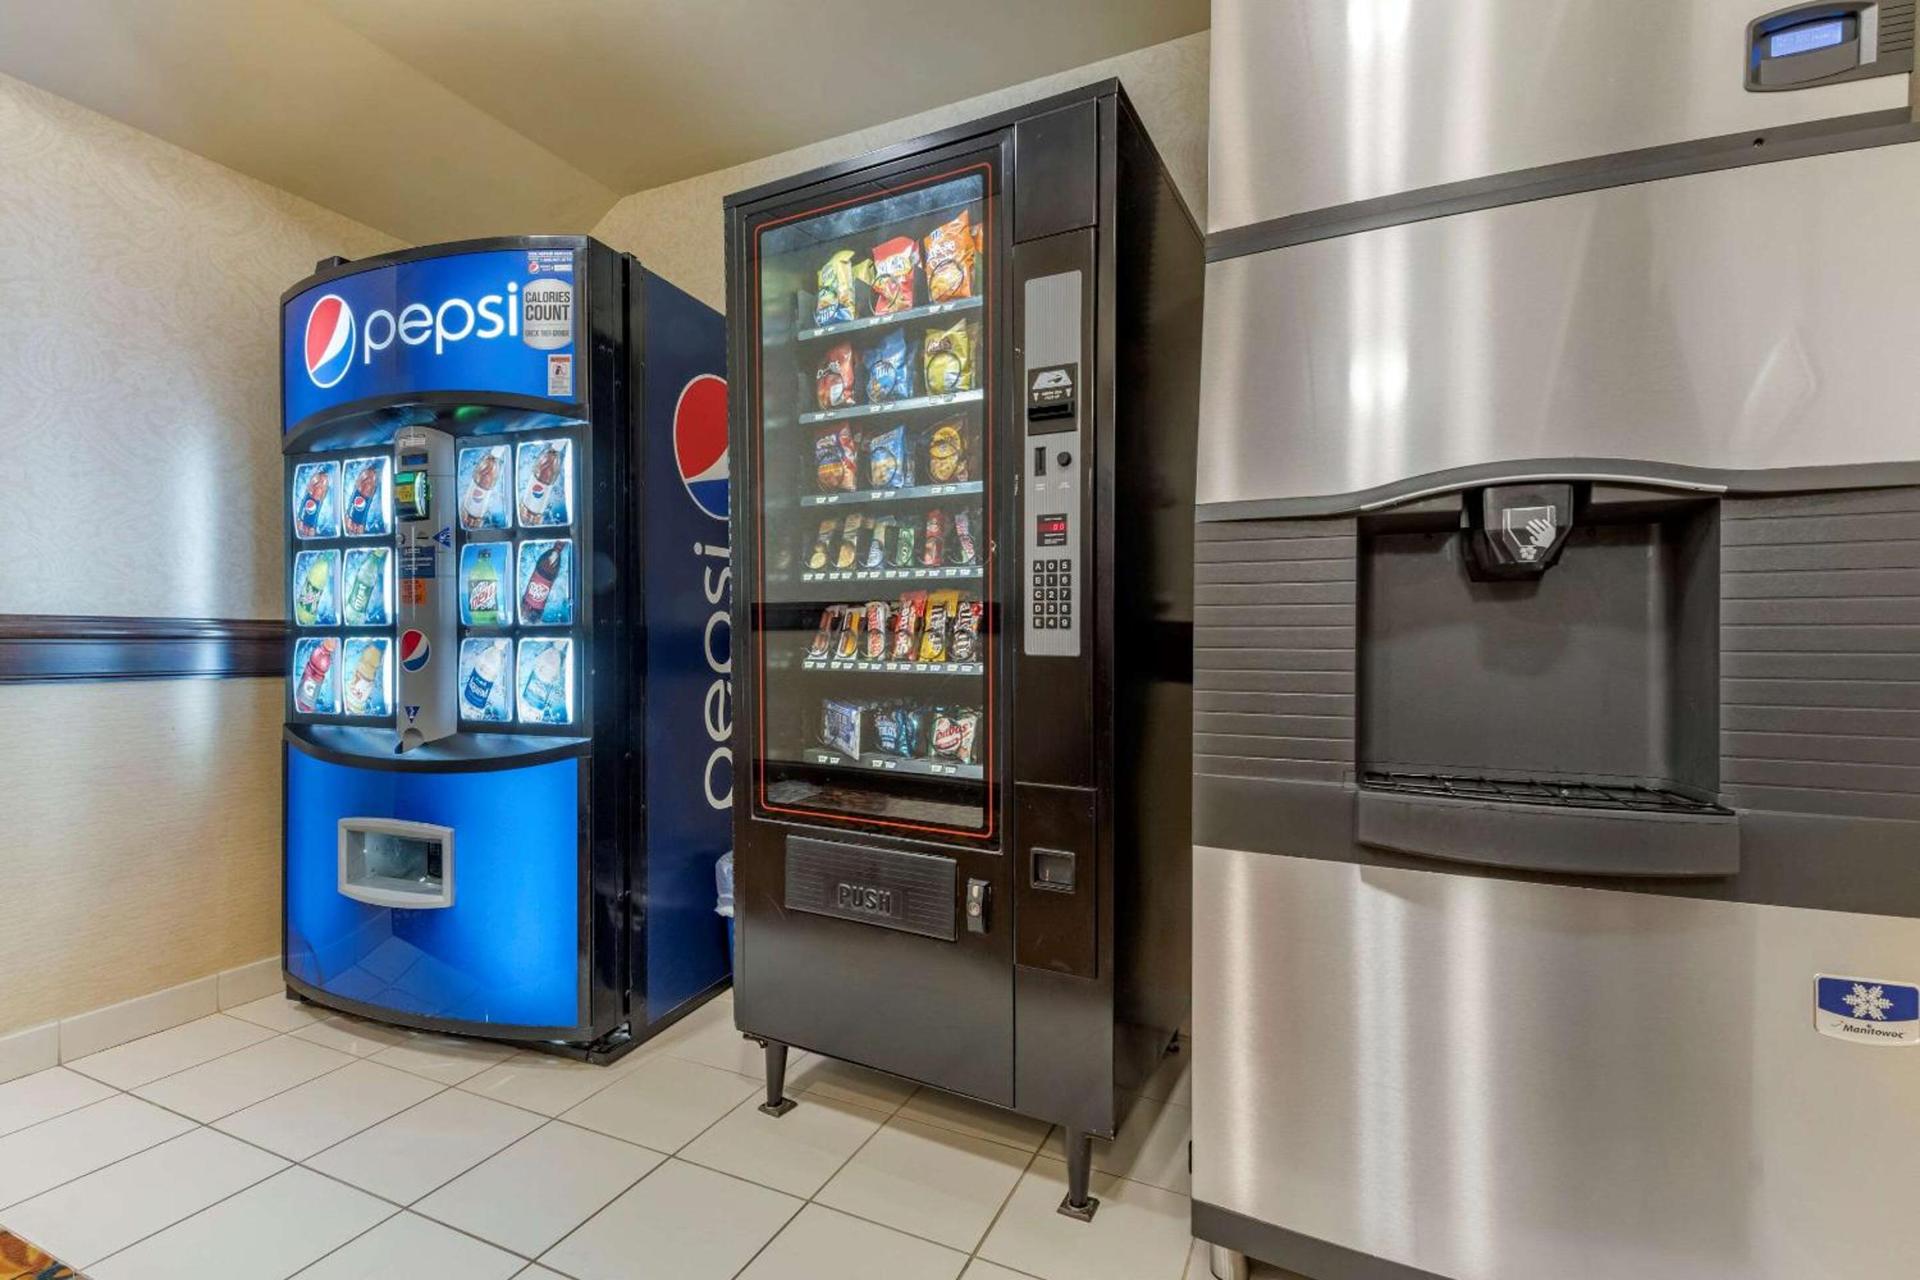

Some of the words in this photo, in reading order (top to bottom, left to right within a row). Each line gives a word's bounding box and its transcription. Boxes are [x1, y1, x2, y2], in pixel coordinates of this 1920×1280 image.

[525, 291, 571, 303] CALORIES
[525, 304, 570, 321] COUNT
[364, 281, 518, 365] pepsi
[837, 882, 893, 916] PUSH
[1842, 1023, 1904, 1039] Manitowoc
